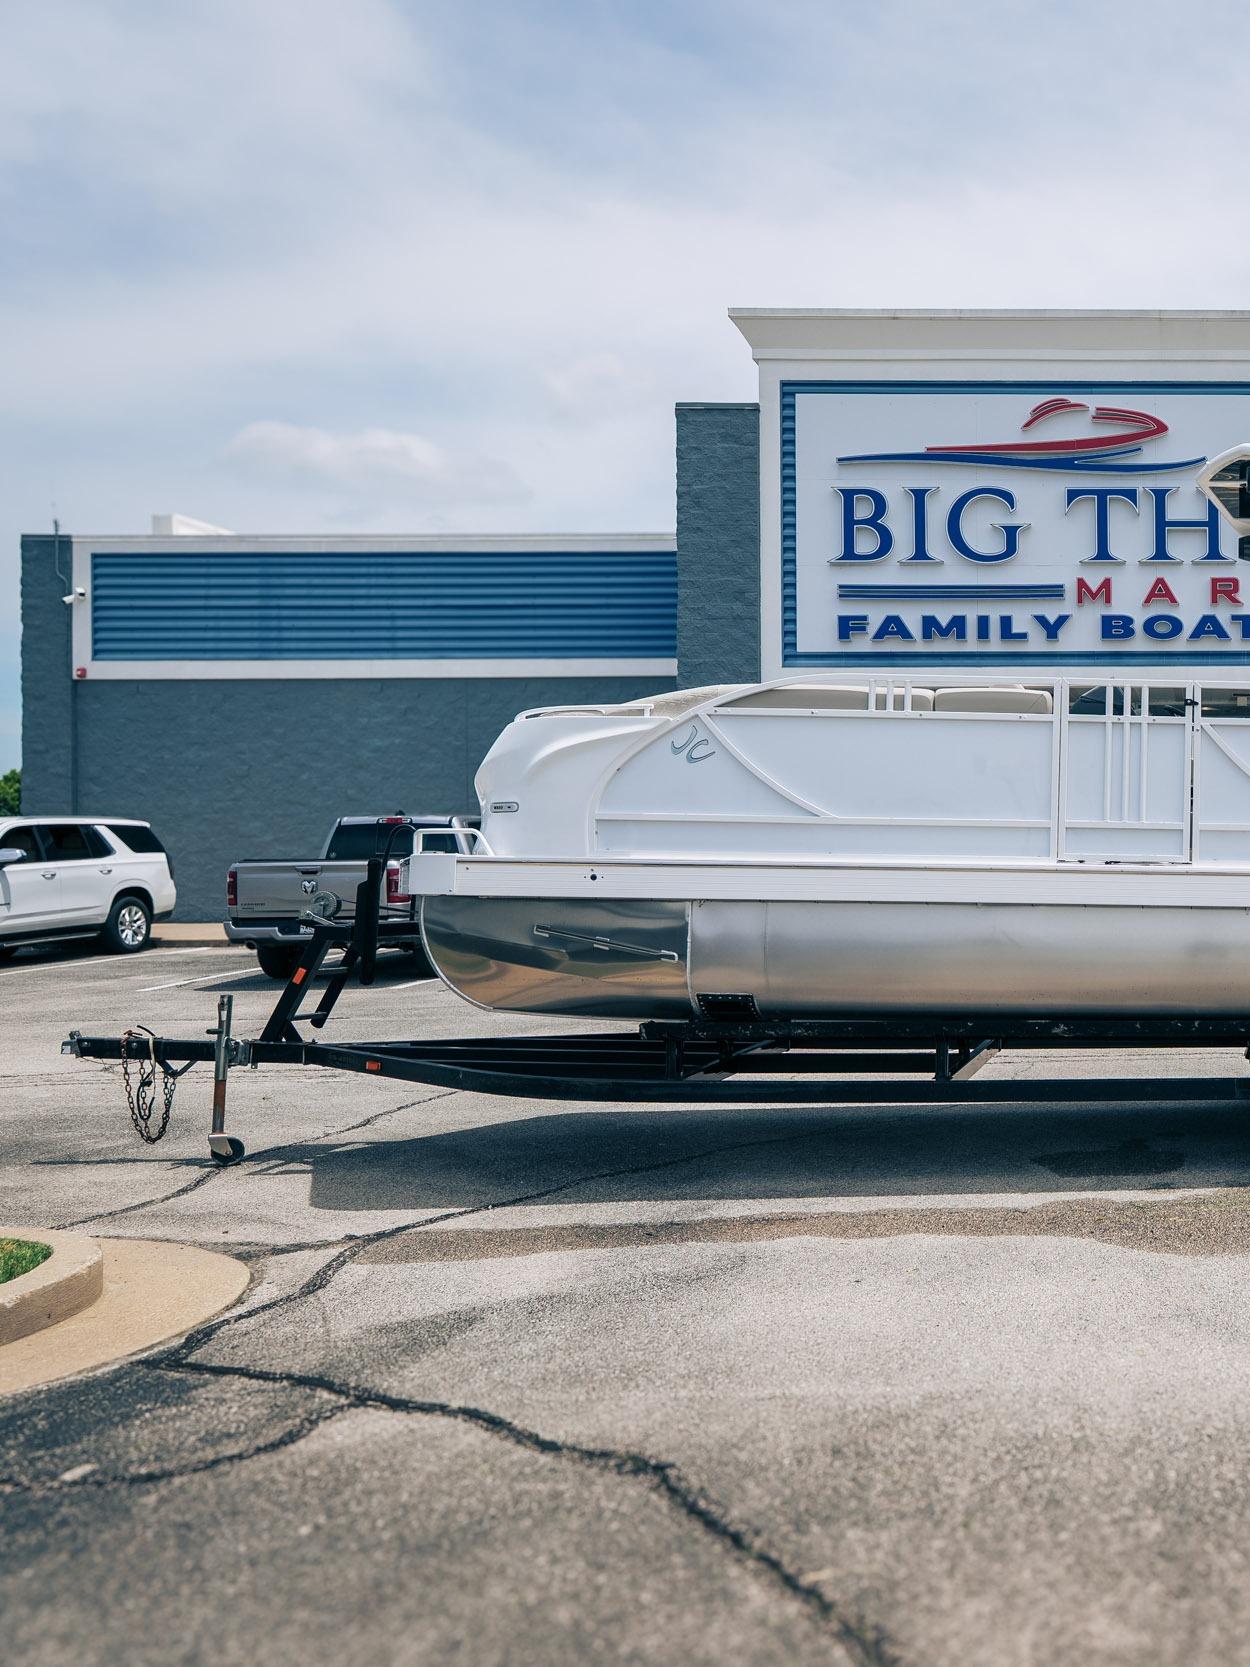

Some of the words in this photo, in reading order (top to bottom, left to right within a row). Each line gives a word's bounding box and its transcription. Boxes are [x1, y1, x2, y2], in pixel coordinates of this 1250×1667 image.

[828, 486, 1031, 564] BIG
[836, 614, 1073, 641] FAMILY
[670, 725, 716, 764] JC
